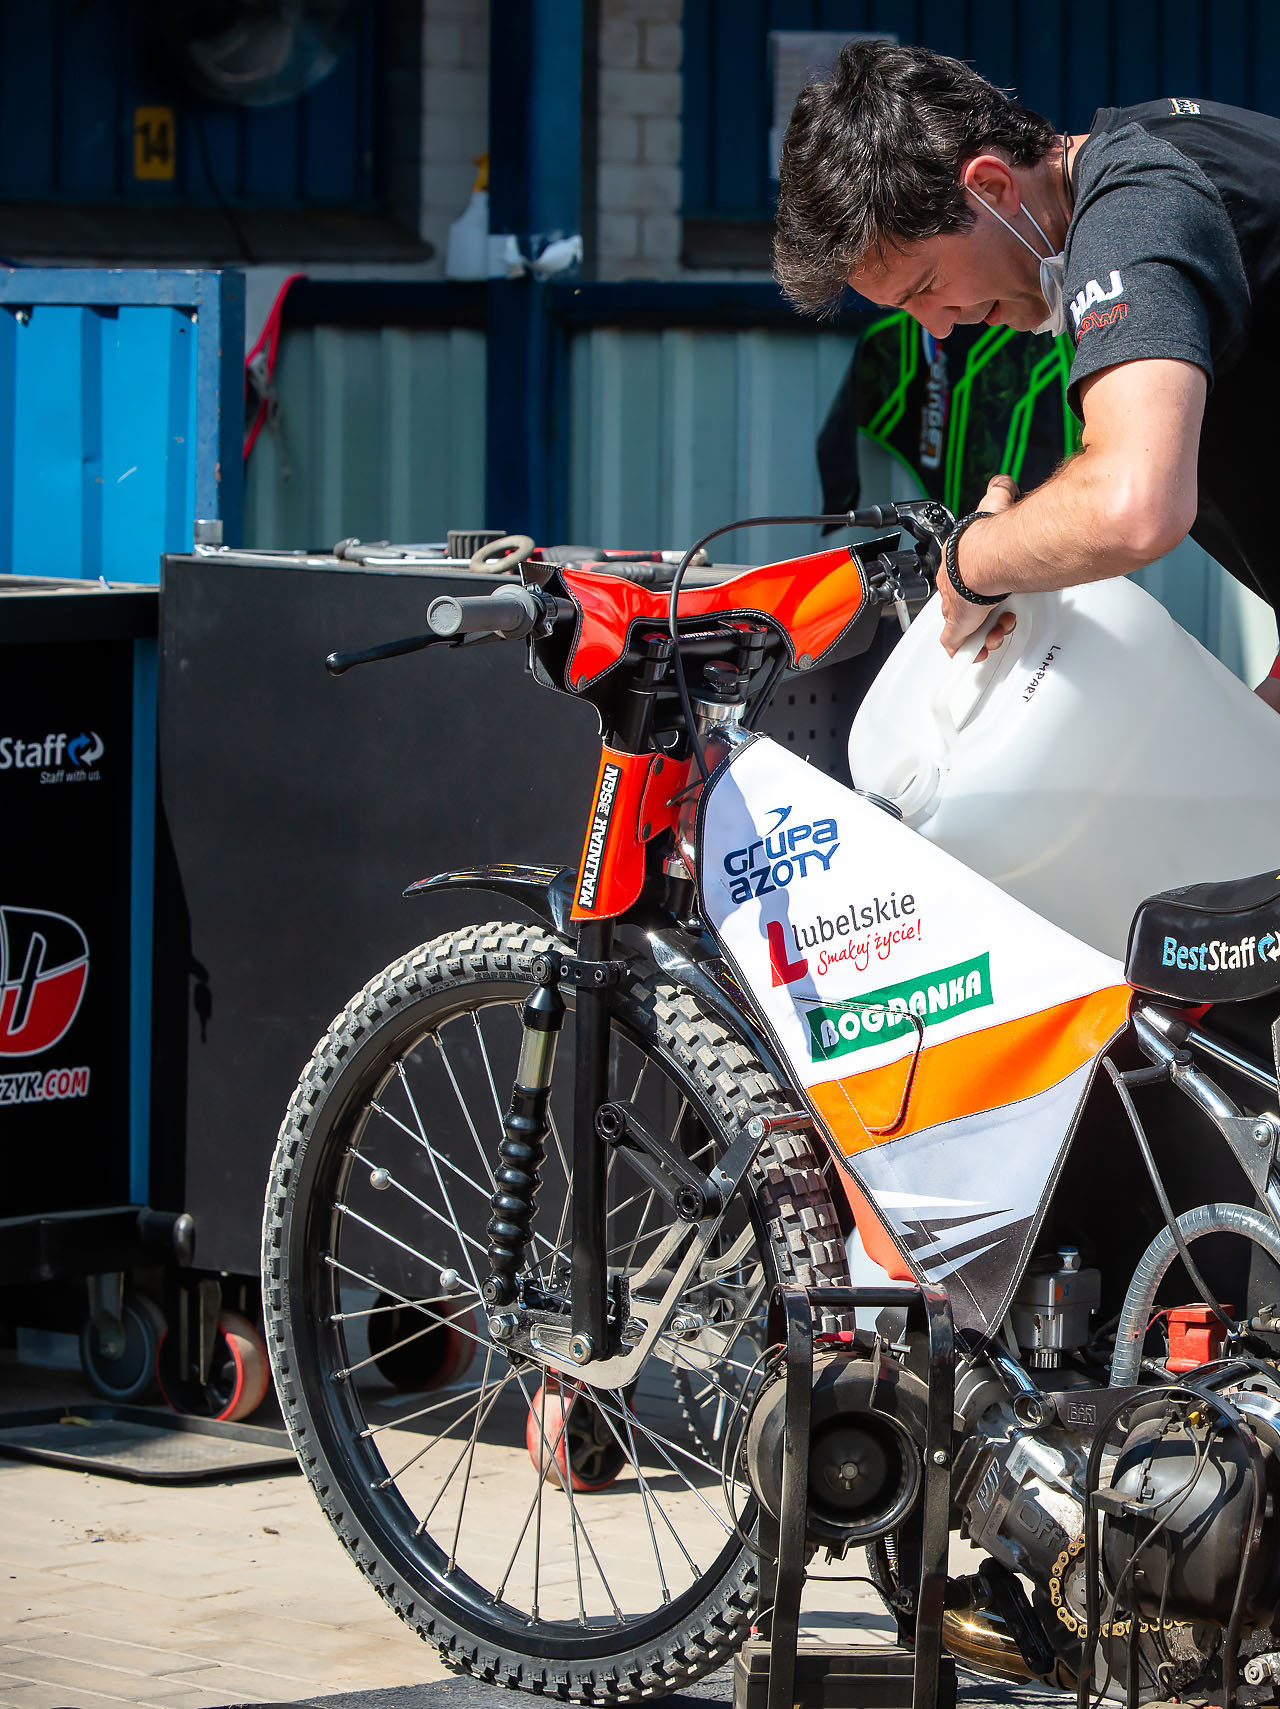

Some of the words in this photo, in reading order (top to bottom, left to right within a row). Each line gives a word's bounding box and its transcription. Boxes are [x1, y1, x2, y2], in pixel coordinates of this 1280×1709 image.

[134, 121, 170, 165] 14
[1022, 645, 1061, 703] LAMPART
[579, 816, 608, 908] MALINIAK
[817, 933, 871, 976] Smakuj
[875, 918, 923, 961] życie!
[1161, 935, 1256, 972] BestStaff
[820, 969, 982, 1049] BOGDANKA
[0, 1067, 90, 1105] ZYK.COM
